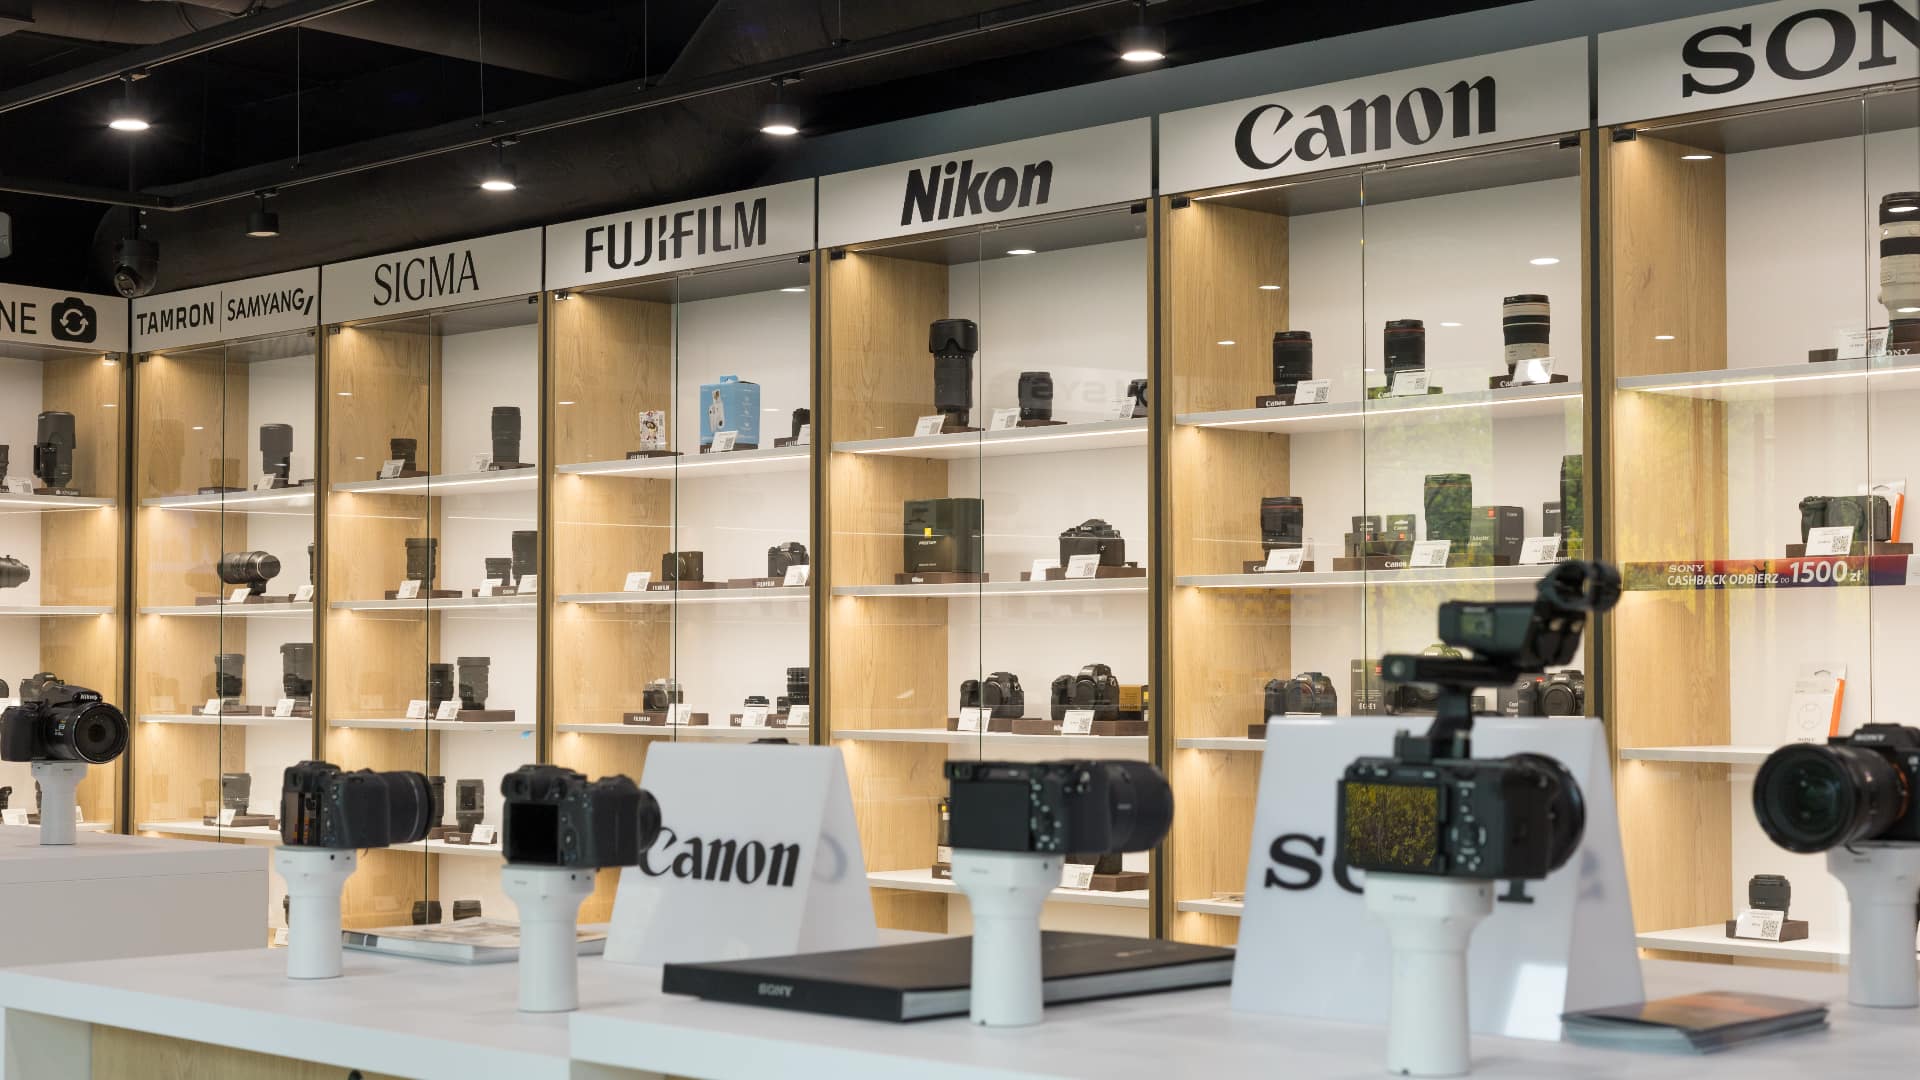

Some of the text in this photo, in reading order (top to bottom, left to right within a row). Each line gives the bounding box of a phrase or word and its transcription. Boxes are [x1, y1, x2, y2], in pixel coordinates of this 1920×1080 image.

[1235, 76, 1497, 169] Canon
[901, 160, 1053, 226] Nikon
[584, 197, 767, 273] FUJIFILM
[373, 250, 480, 306] SIGMA
[137, 302, 215, 336] TAMRON
[1384, 560, 1407, 568] Canon
[1667, 573, 1727, 586] CASHBACK
[1729, 572, 1778, 585] ODBIERZ
[1789, 560, 1848, 583] 1500
[1848, 570, 1863, 582] zł
[1668, 563, 1705, 573] SONY
[638, 827, 800, 887] Canon
[758, 983, 794, 998] SONY
